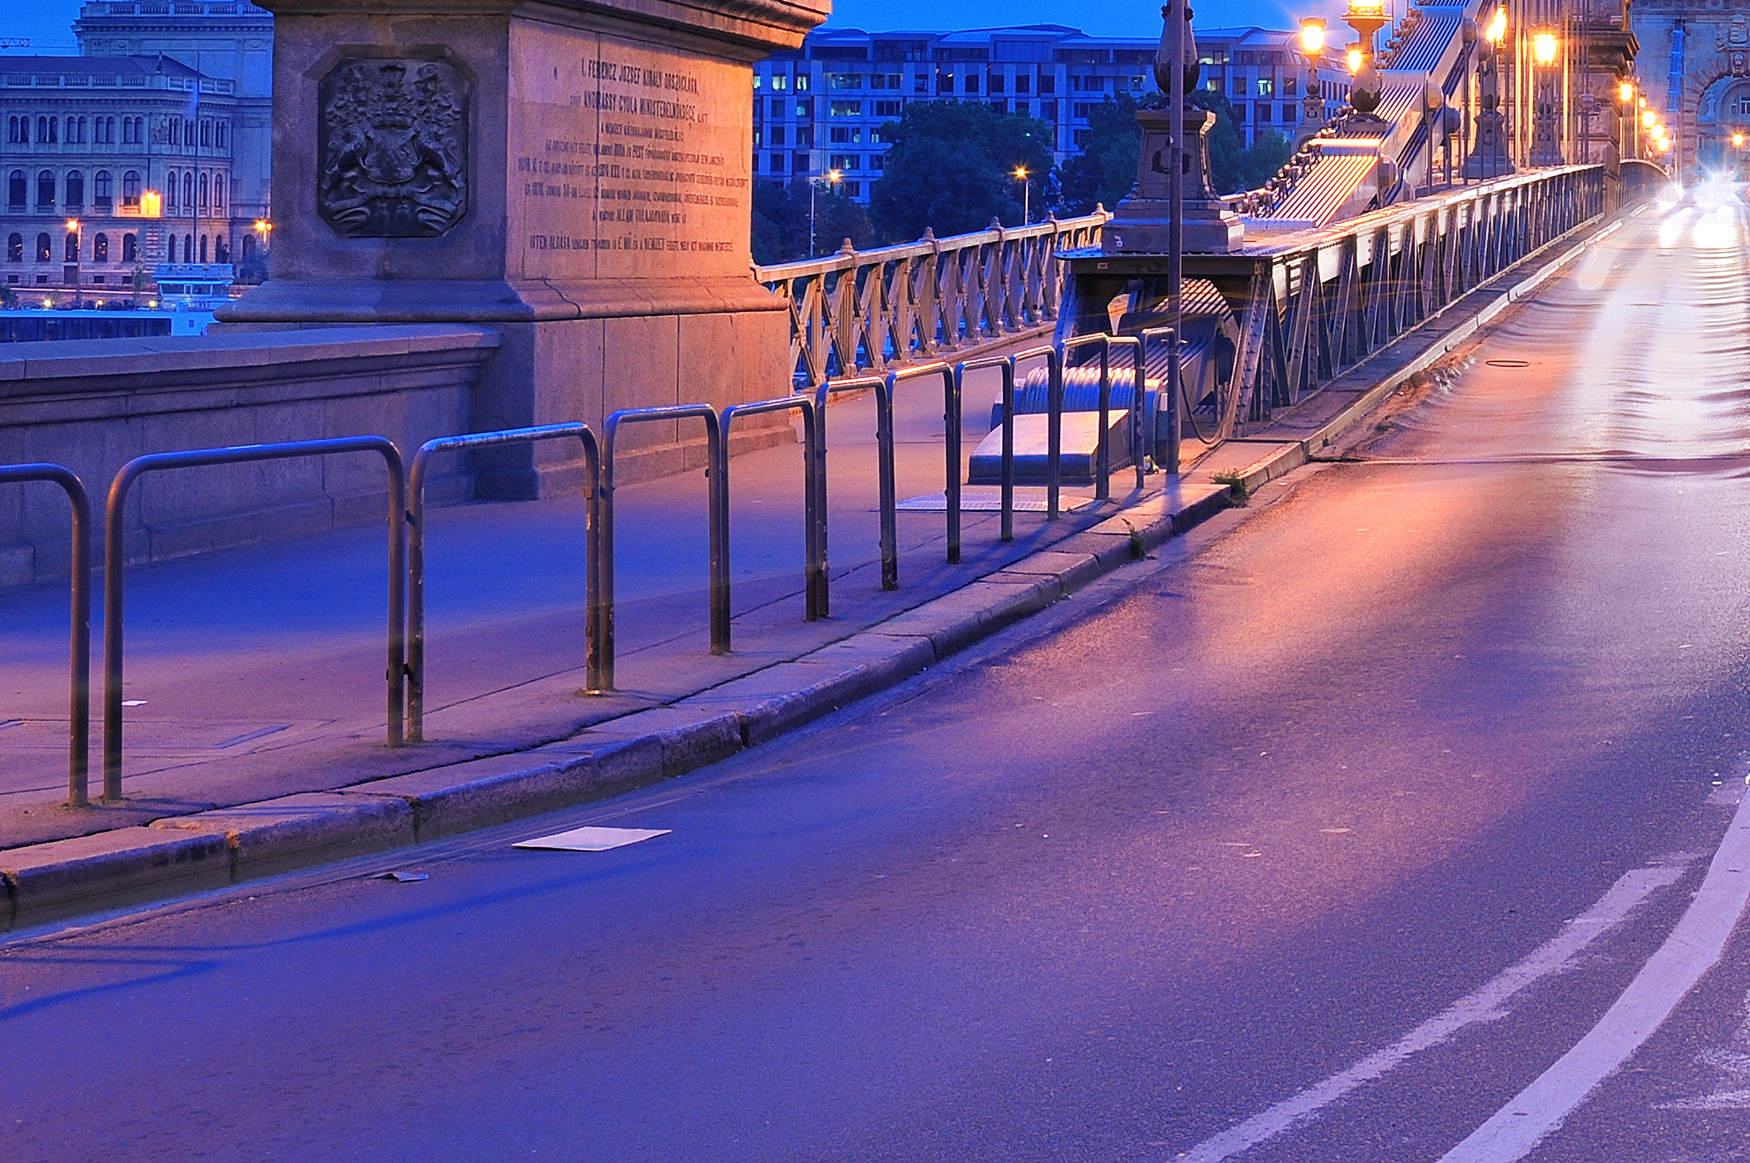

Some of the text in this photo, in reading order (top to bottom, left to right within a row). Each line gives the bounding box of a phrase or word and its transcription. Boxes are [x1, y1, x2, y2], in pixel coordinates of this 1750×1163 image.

[619, 60, 641, 84] JÓZSEF
[643, 64, 662, 89] KIRÁLY
[619, 95, 638, 115] GYULA
